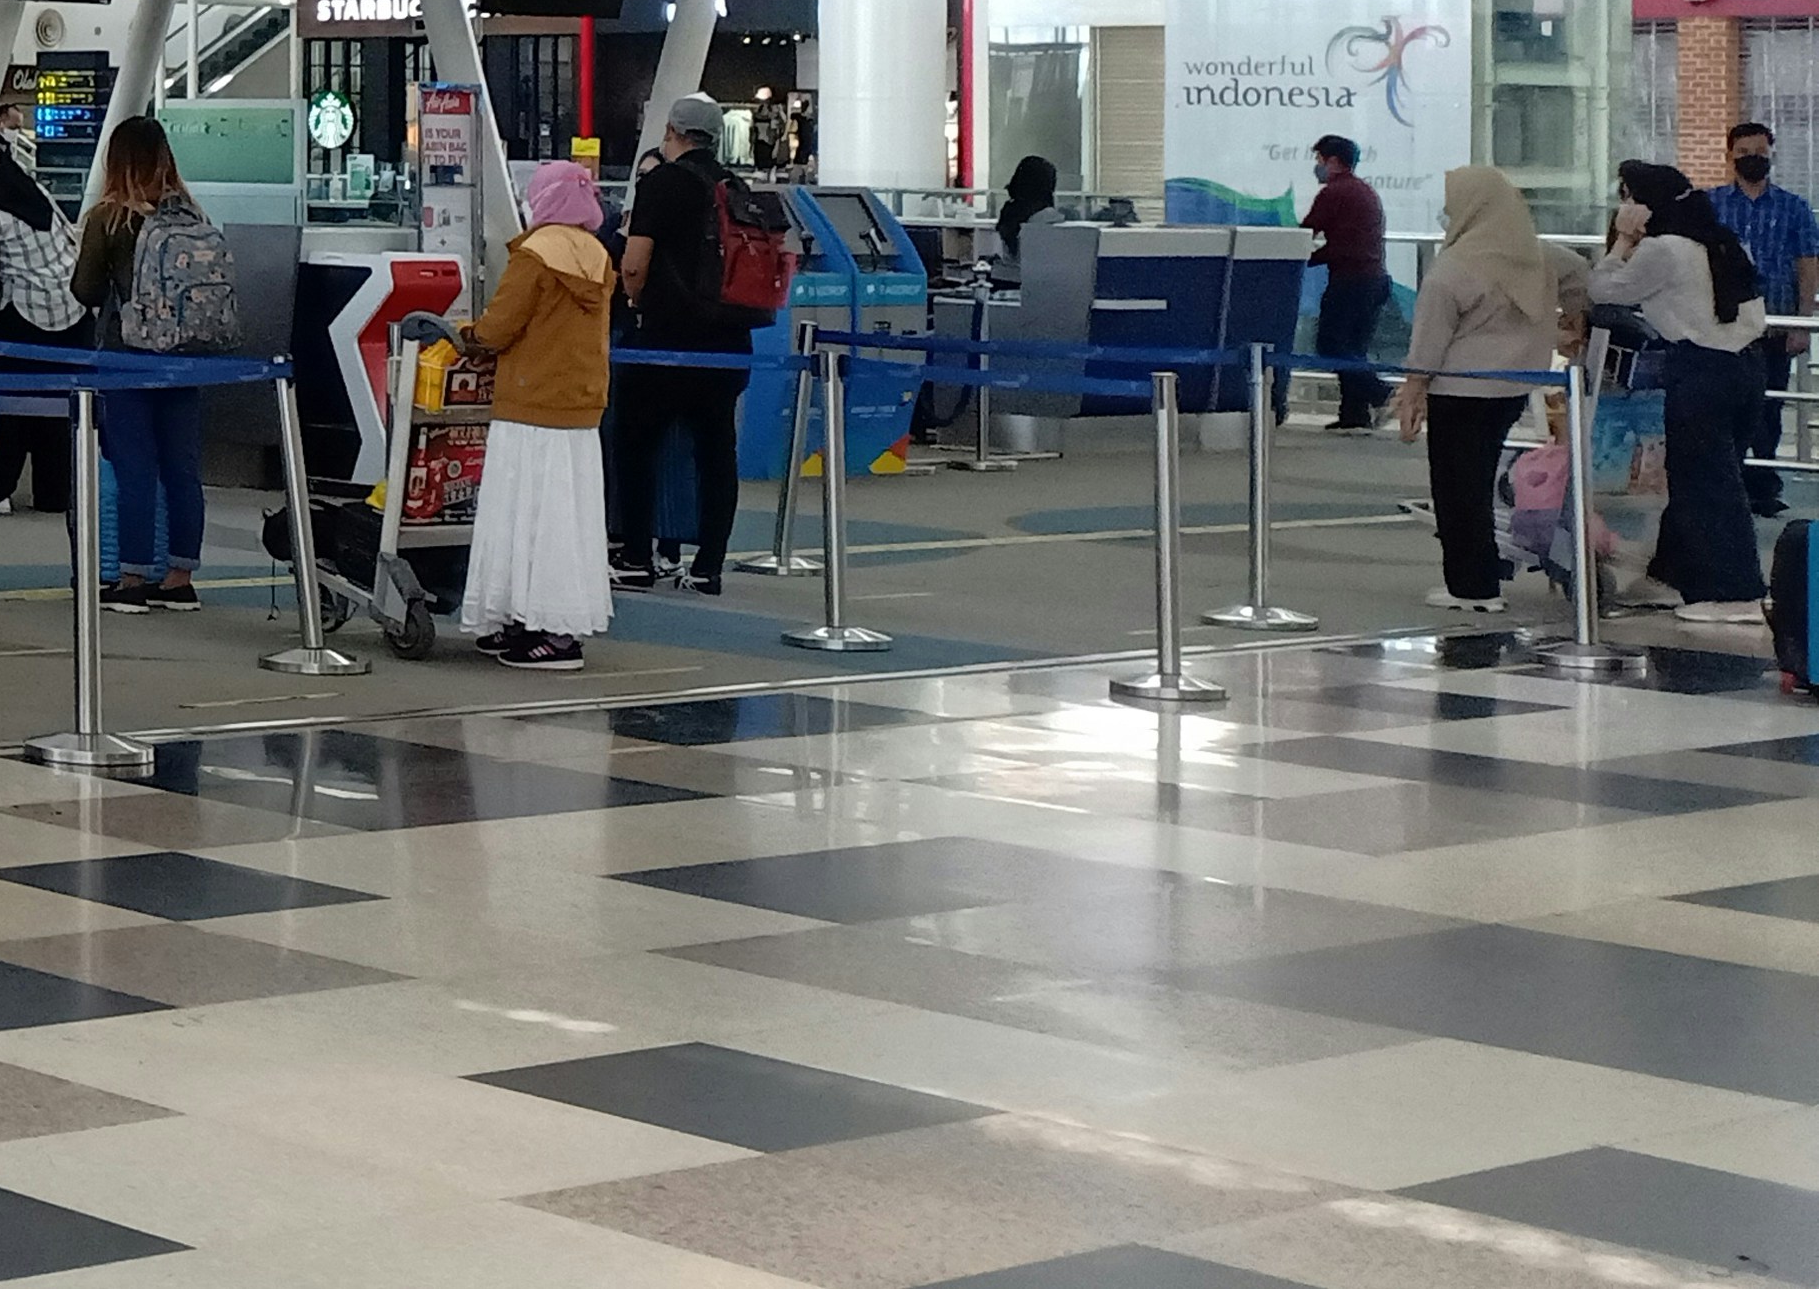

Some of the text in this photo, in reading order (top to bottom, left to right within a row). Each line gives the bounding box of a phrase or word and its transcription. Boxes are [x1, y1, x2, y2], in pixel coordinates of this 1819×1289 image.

[1183, 55, 1315, 76] wonderful
[1182, 77, 1357, 108] indonesia
[435, 128, 461, 139] YOUR
[425, 141, 447, 151] ABIN
